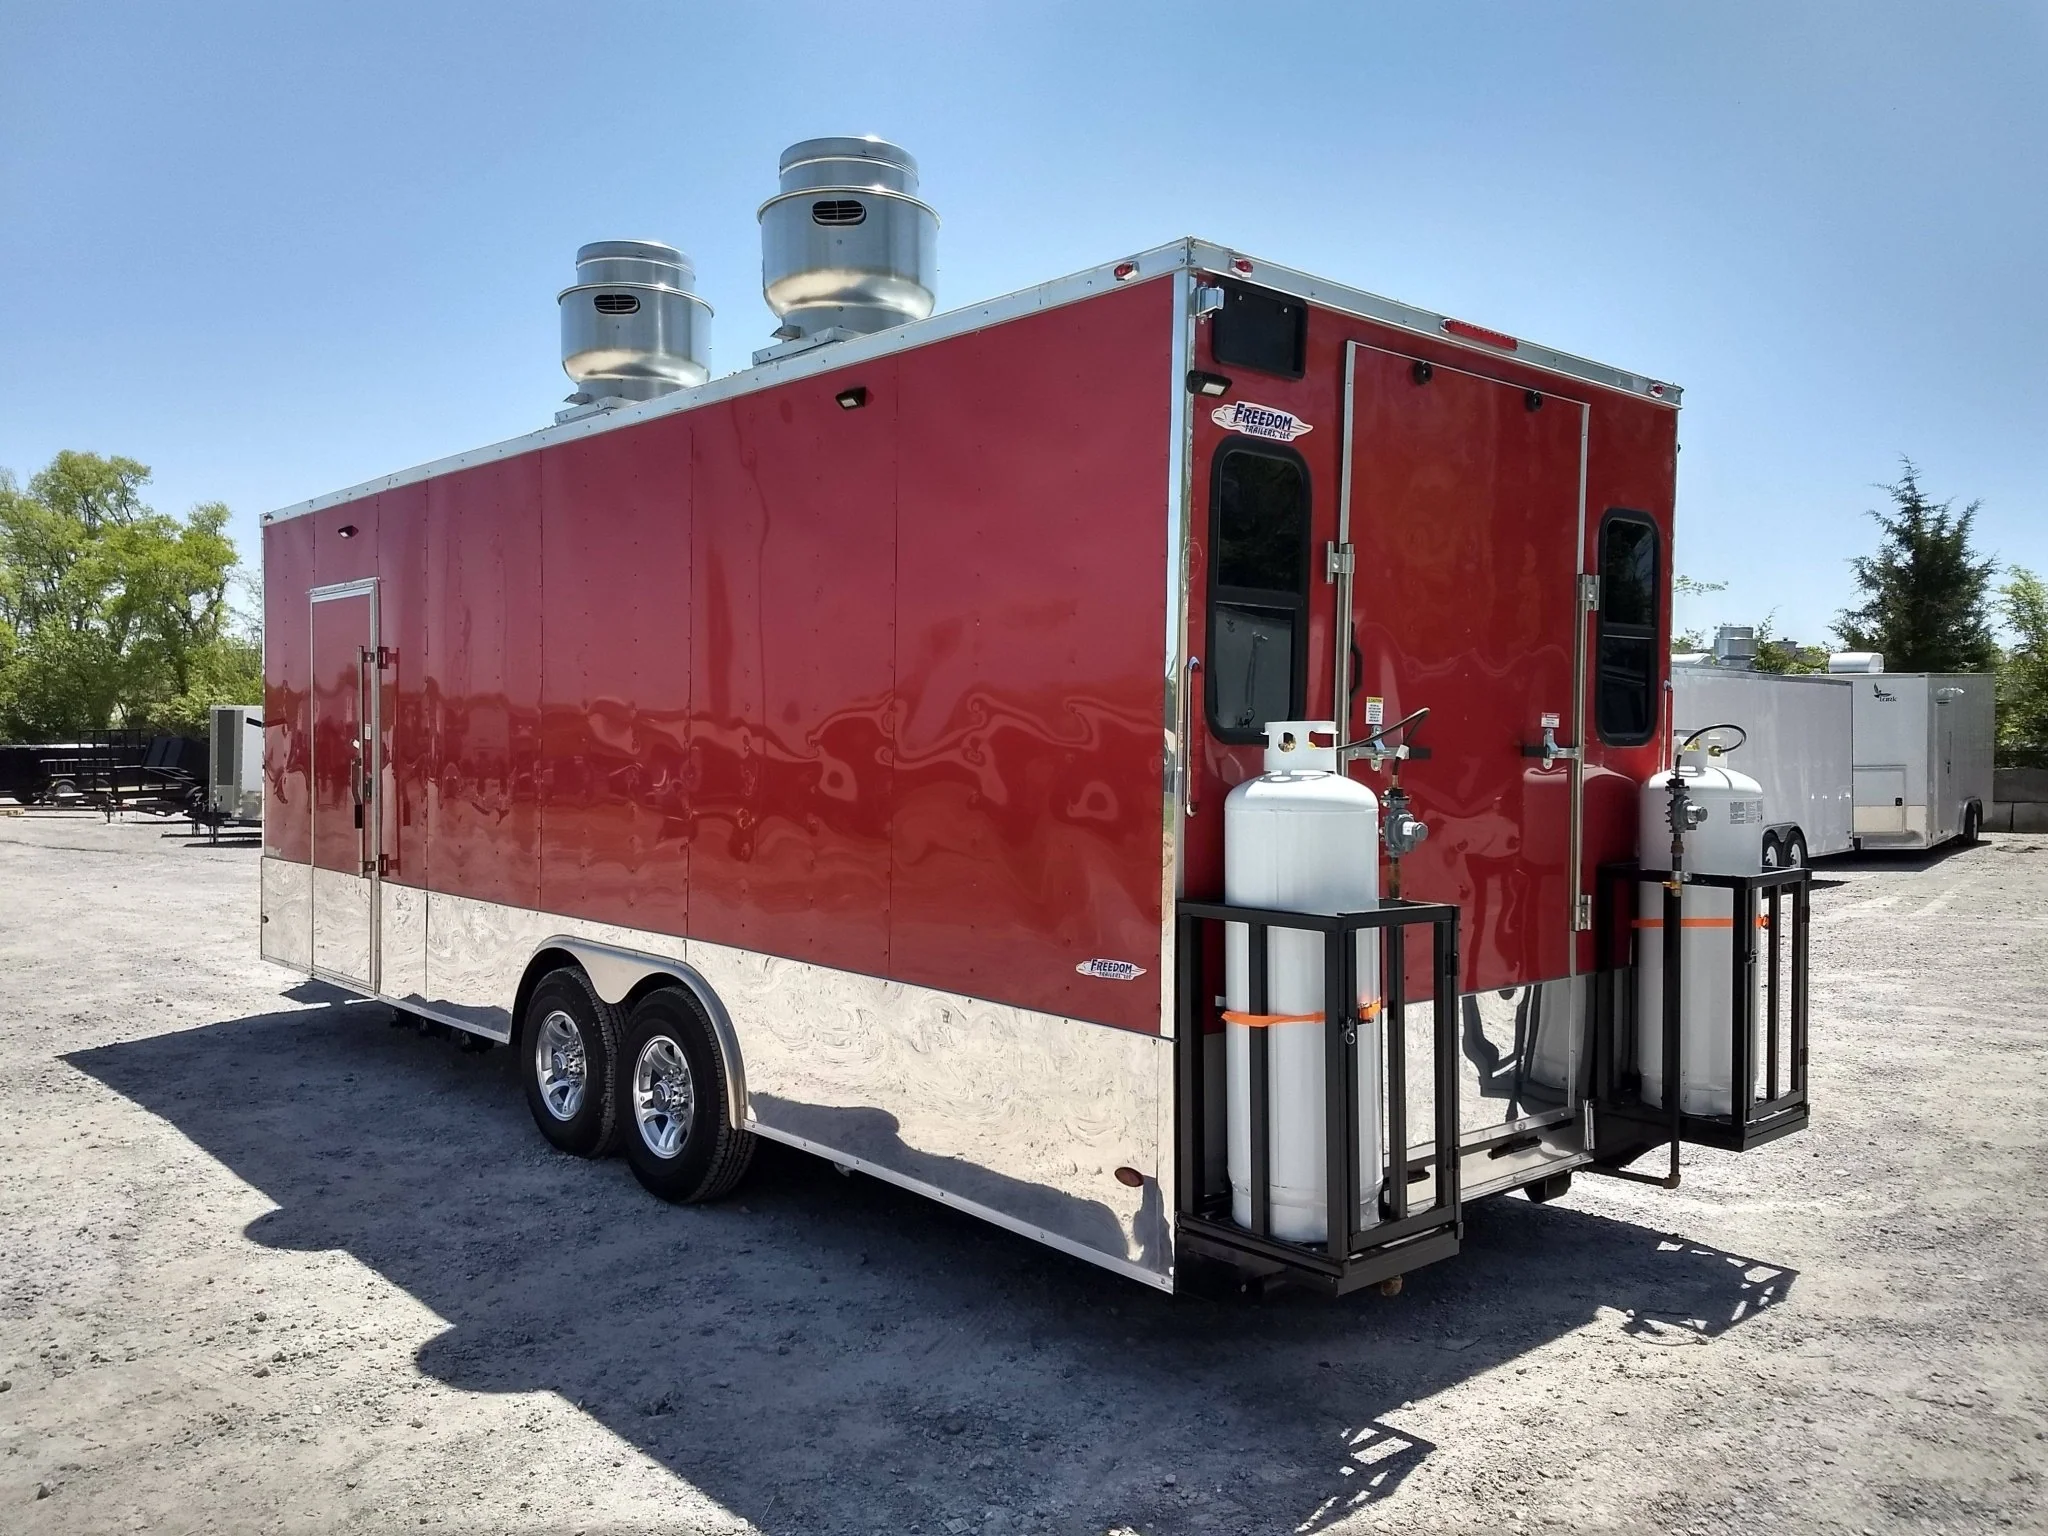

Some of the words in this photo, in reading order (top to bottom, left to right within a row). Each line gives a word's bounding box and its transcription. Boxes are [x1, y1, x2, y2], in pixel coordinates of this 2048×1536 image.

[1233, 403, 1292, 431] FREEDOM
[1244, 425, 1277, 438] TRAILERS,
[1279, 431, 1291, 440] LLC
[1090, 959, 1133, 973] FREEDOM
